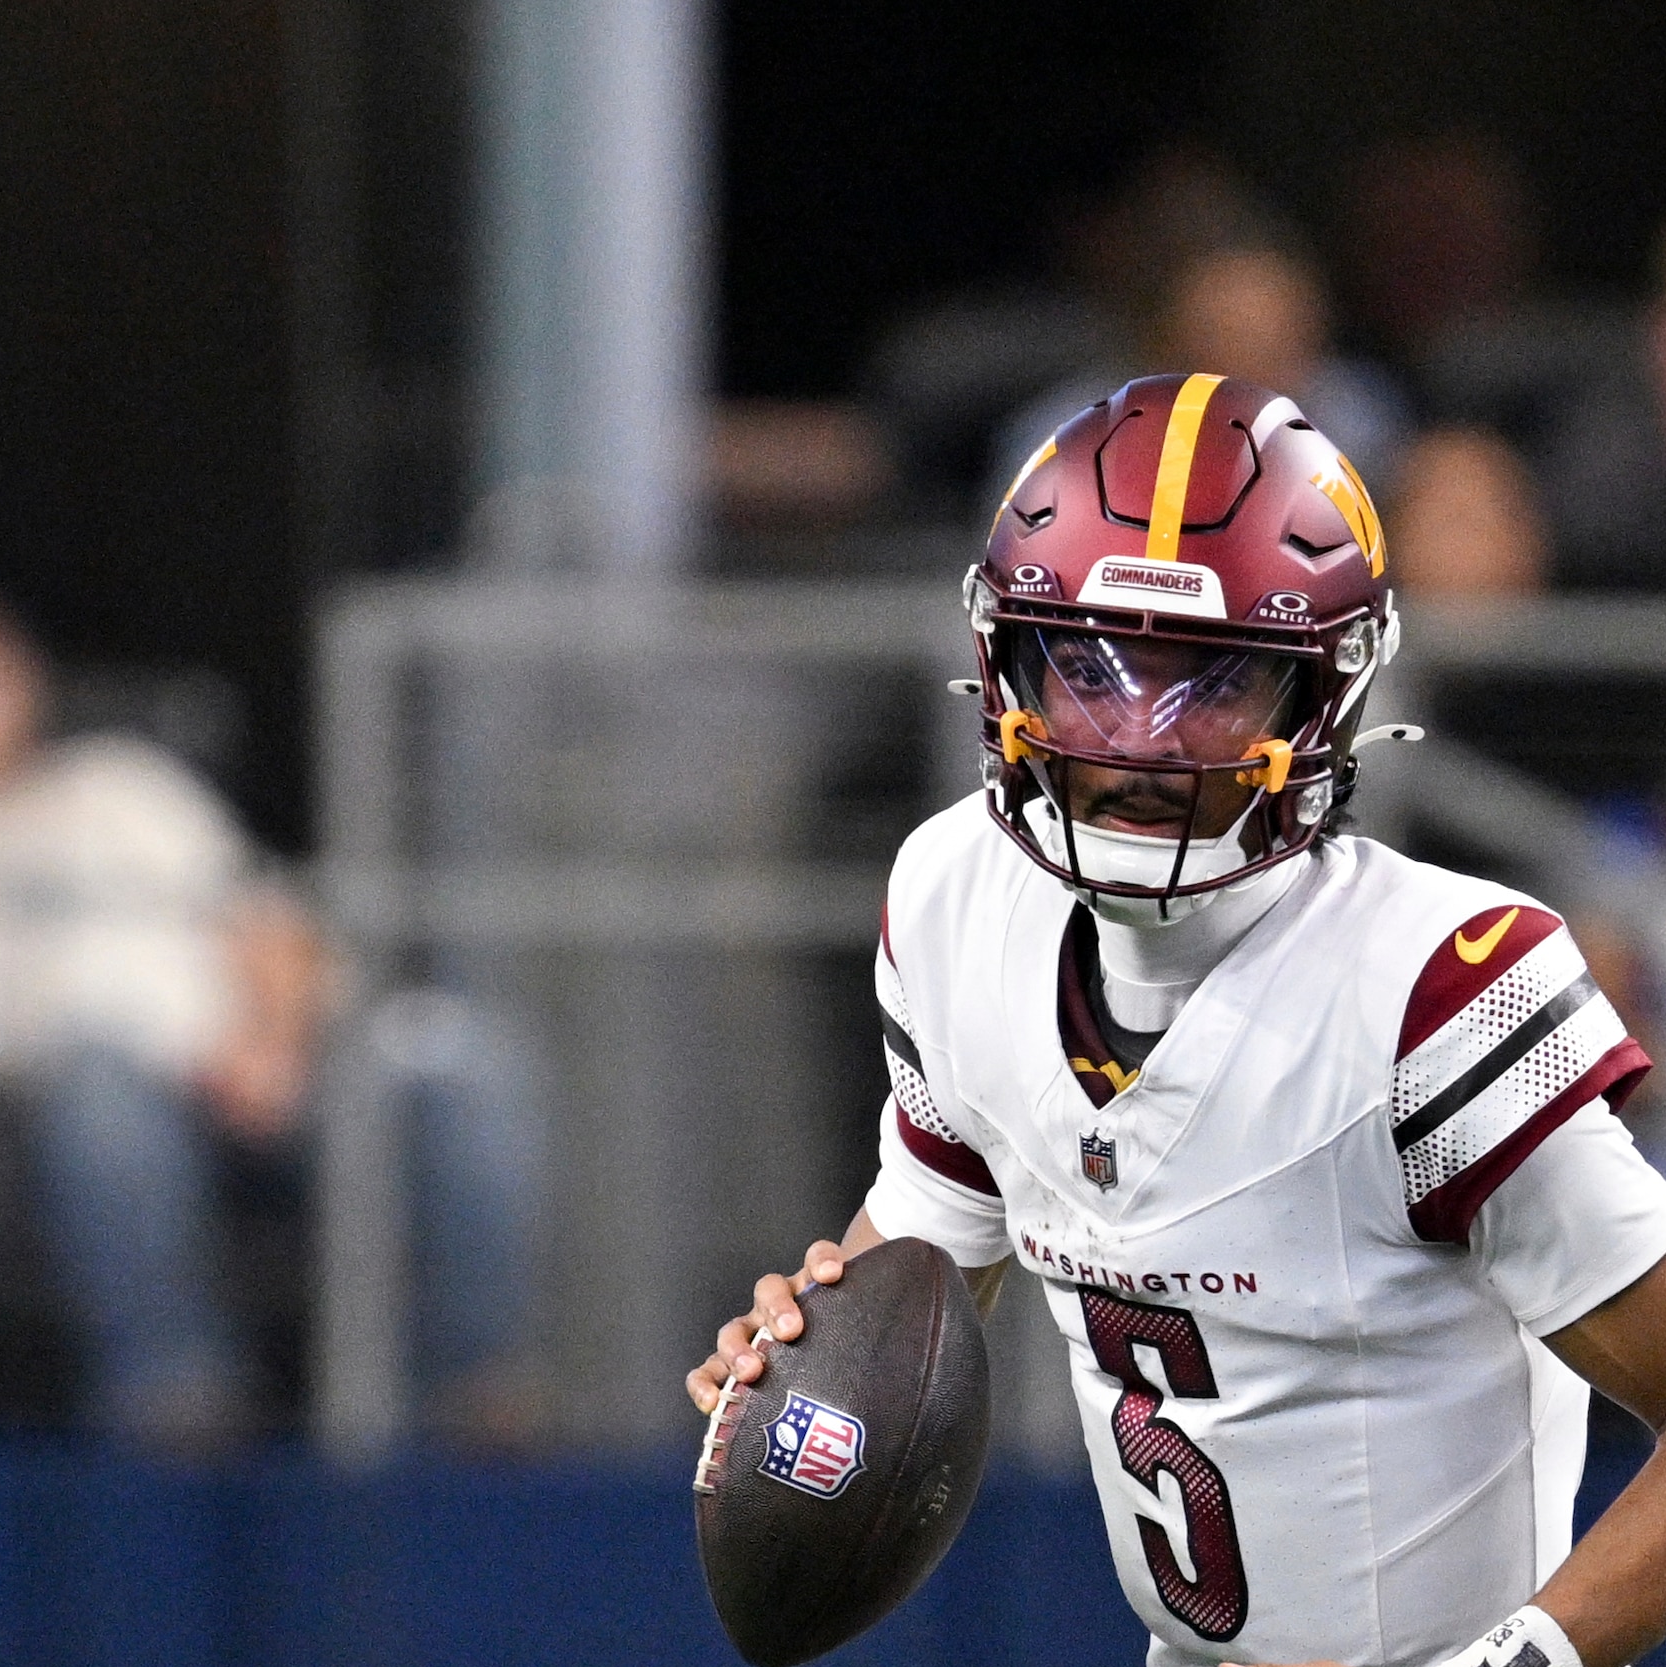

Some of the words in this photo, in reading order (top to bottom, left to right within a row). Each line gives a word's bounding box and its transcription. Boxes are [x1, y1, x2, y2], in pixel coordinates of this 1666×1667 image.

[1010, 583, 1053, 593] OAKLEY
[1101, 566, 1204, 593] COMMANDERS
[1259, 607, 1315, 625] OAKLEY
[1085, 1155, 1113, 1180] NFL
[1021, 1230, 1258, 1294] WASHINGTON
[795, 1421, 855, 1489] NFL
[1076, 1283, 1250, 1643] 5
